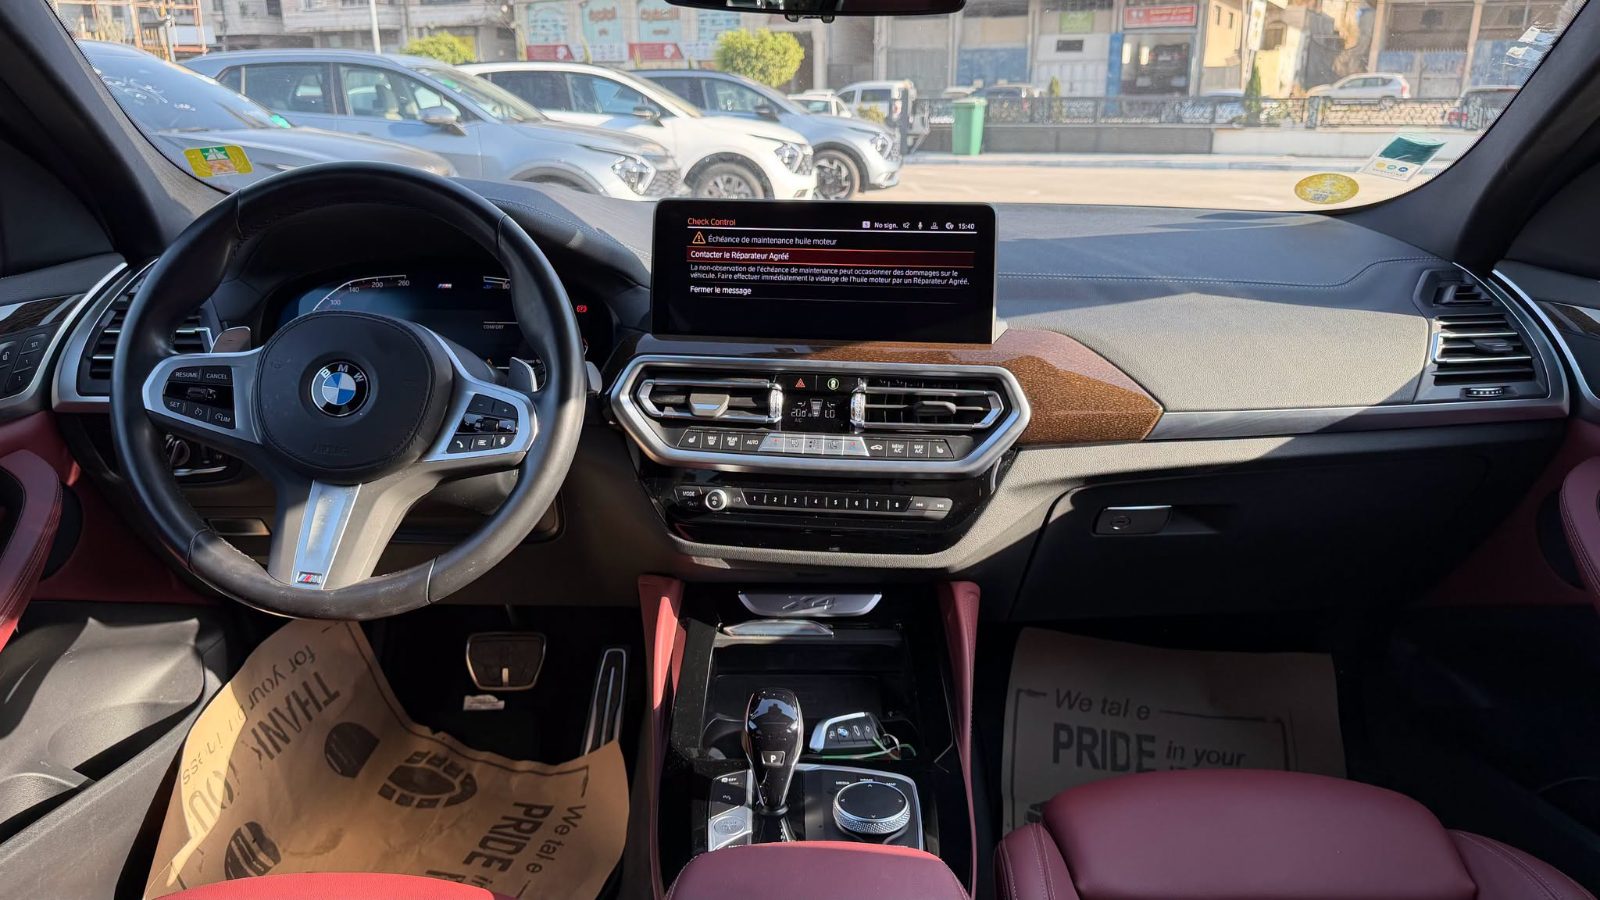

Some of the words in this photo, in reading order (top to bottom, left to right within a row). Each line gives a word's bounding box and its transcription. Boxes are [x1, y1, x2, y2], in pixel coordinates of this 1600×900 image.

[688, 217, 710, 225] Check
[710, 218, 736, 226] Control
[708, 234, 740, 243] Échéance
[741, 235, 749, 243] de
[751, 236, 794, 244] maintenance
[795, 236, 812, 245] huile
[812, 238, 837, 246] moteur
[723, 251, 730, 259] le
[731, 251, 768, 261] Réparateur
[769, 252, 789, 261] Agréé
[699, 264, 747, 272] non-observation
[757, 265, 789, 273] l'échéance
[839, 268, 853, 276] peut
[762, 273, 808, 281] immédiatement
[815, 275, 839, 283] vidange
[913, 277, 948, 285] Réparateur
[948, 278, 970, 286] Agréé.
[690, 286, 714, 294] Fermer
[714, 286, 721, 294] le
[722, 287, 752, 295] message
[320, 364, 364, 382] BMW
[288, 644, 316, 674] for
[248, 664, 286, 711] your
[1056, 688, 1092, 712] We
[242, 671, 340, 770] THANK
[1052, 722, 1157, 774] PRIDE
[1166, 740, 1185, 760] in
[1192, 748, 1246, 768] your
[770, 755, 777, 763] P
[554, 804, 586, 836] We
[462, 802, 554, 872] PRIDE
